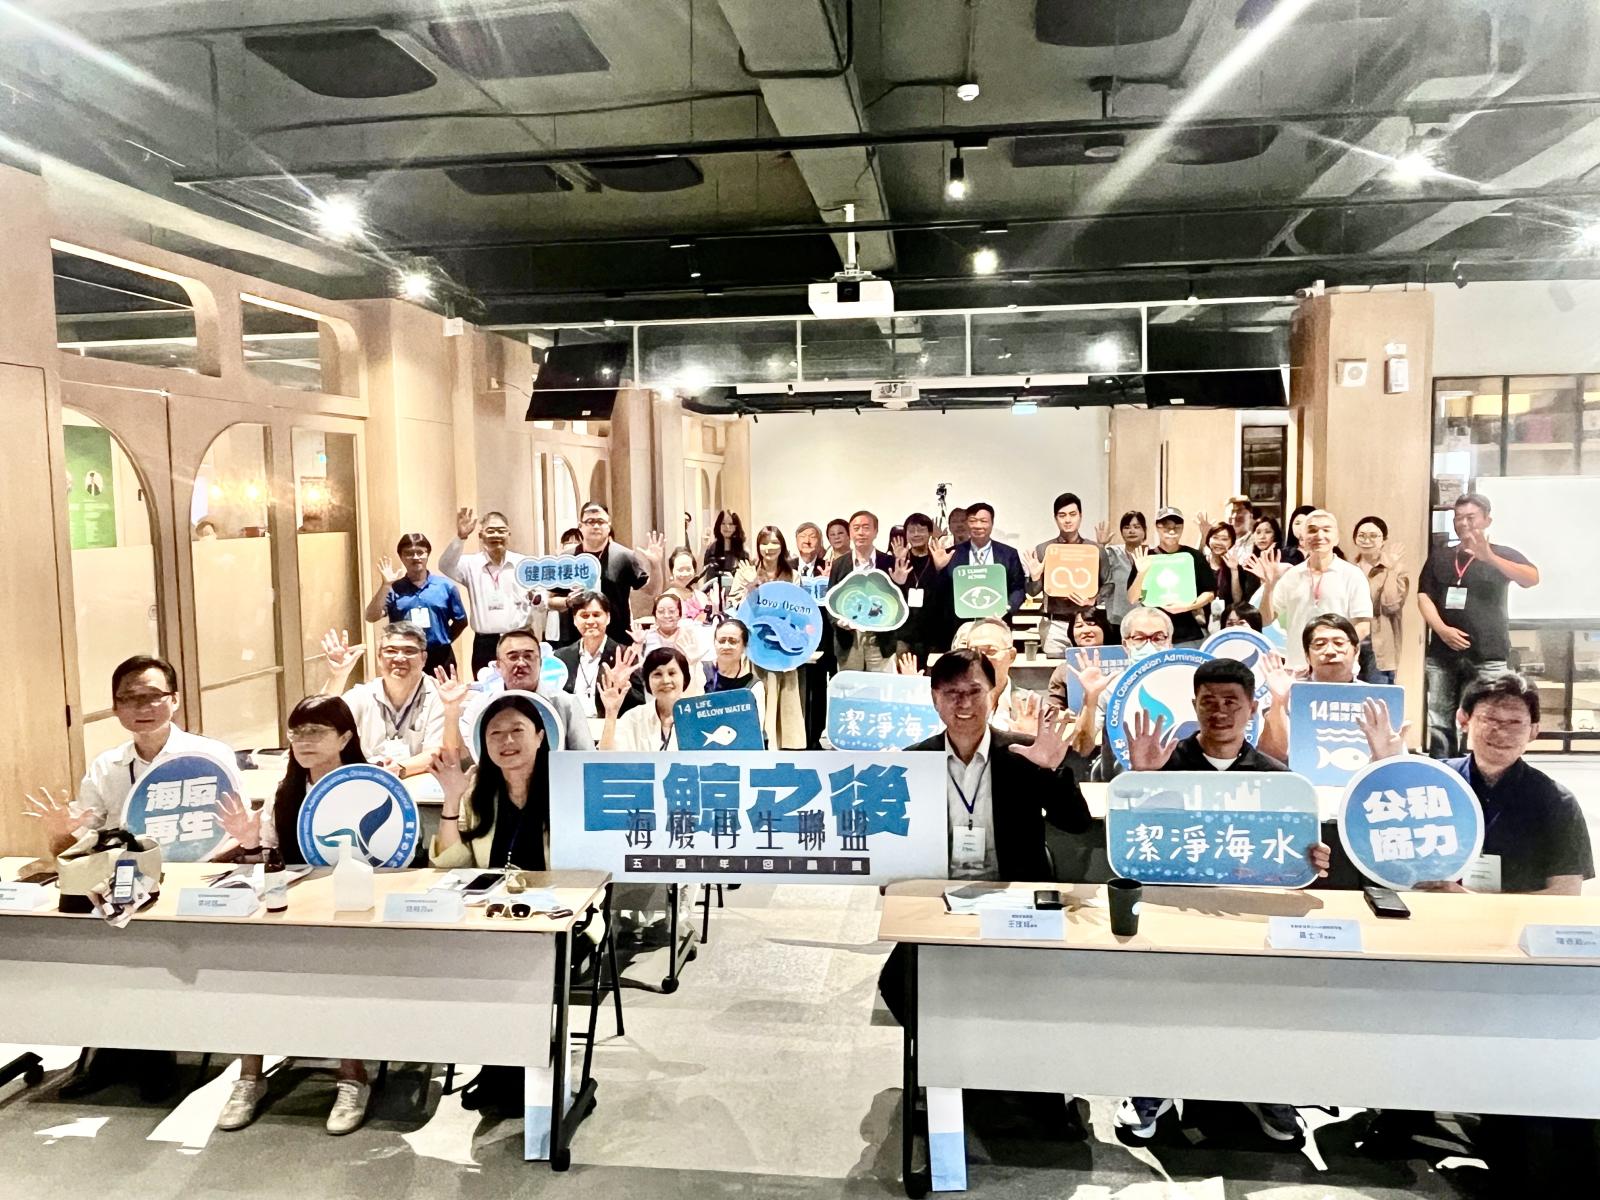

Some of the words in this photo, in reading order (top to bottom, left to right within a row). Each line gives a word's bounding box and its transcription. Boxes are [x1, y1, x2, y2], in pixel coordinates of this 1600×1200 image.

[524, 563, 590, 582] 健康棲地
[677, 703, 692, 715] 14
[695, 699, 713, 709] LIFE
[1110, 698, 1121, 728] Ocean
[1116, 656, 1162, 698] Conservation
[697, 708, 724, 719] BELOW
[724, 703, 751, 714] WATER
[1310, 700, 1328, 720] 14
[584, 762, 911, 836] 巨鯨之後
[144, 811, 214, 844] 再生
[624, 808, 869, 851] 海廢再生聯盟
[1125, 823, 1303, 864] 潔淨海水
[1368, 824, 1458, 862] 協力
